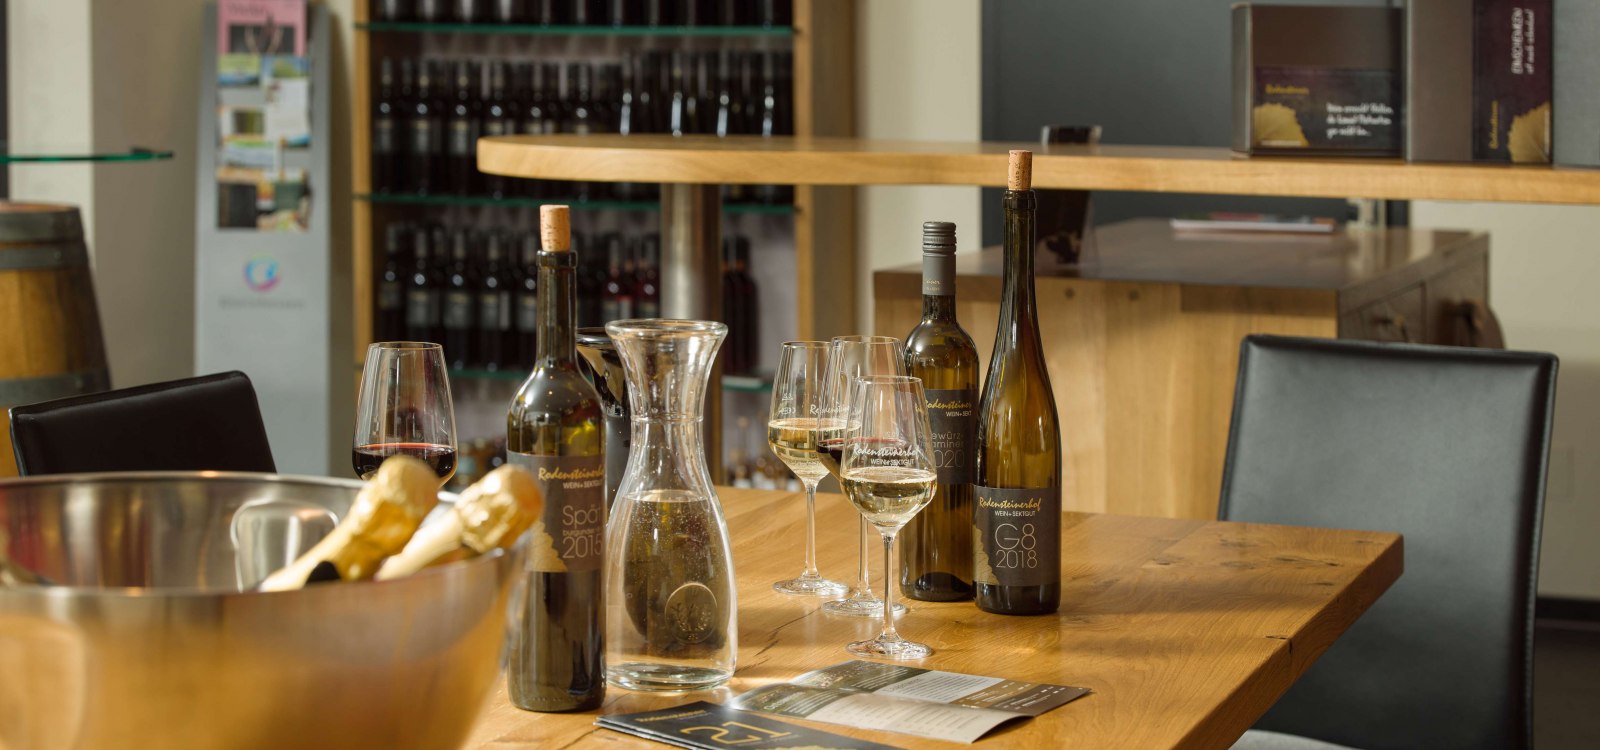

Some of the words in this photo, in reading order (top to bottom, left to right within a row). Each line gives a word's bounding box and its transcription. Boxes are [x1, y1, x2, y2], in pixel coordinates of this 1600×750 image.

[979, 496, 1042, 512] Rodensteinerhof
[994, 522, 1037, 551] G8
[995, 549, 1038, 569] 2018
